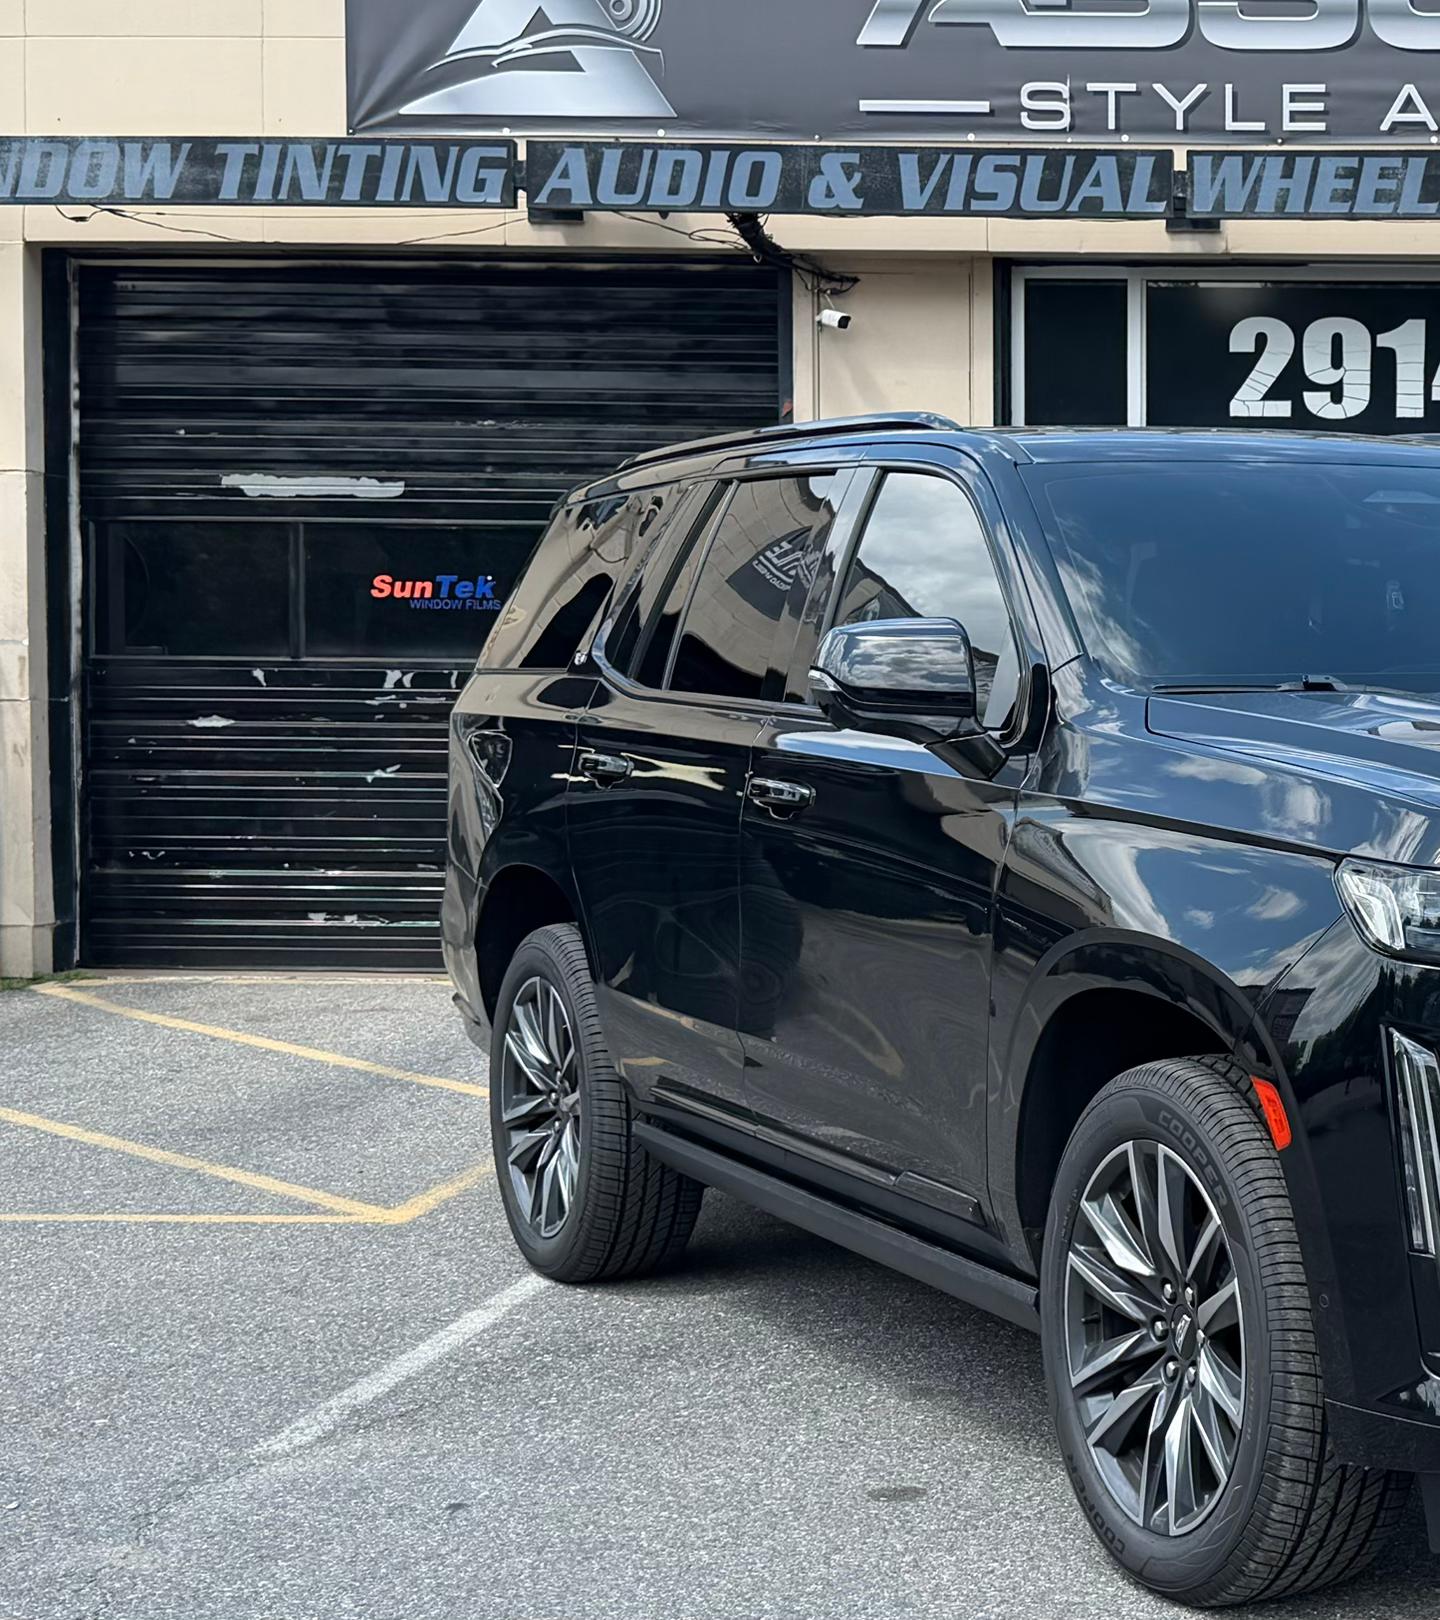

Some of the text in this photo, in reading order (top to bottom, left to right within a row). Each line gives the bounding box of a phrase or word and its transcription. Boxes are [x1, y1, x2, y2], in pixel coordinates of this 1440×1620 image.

[1020, 80, 1327, 131] STYLE
[214, 143, 508, 203] TINTING
[541, 149, 1168, 213] AUDIO & VISUAL
[370, 574, 497, 599] SunTek
[409, 599, 501, 611] WINDOW FILMS
[1158, 1109, 1229, 1207] COOPER
